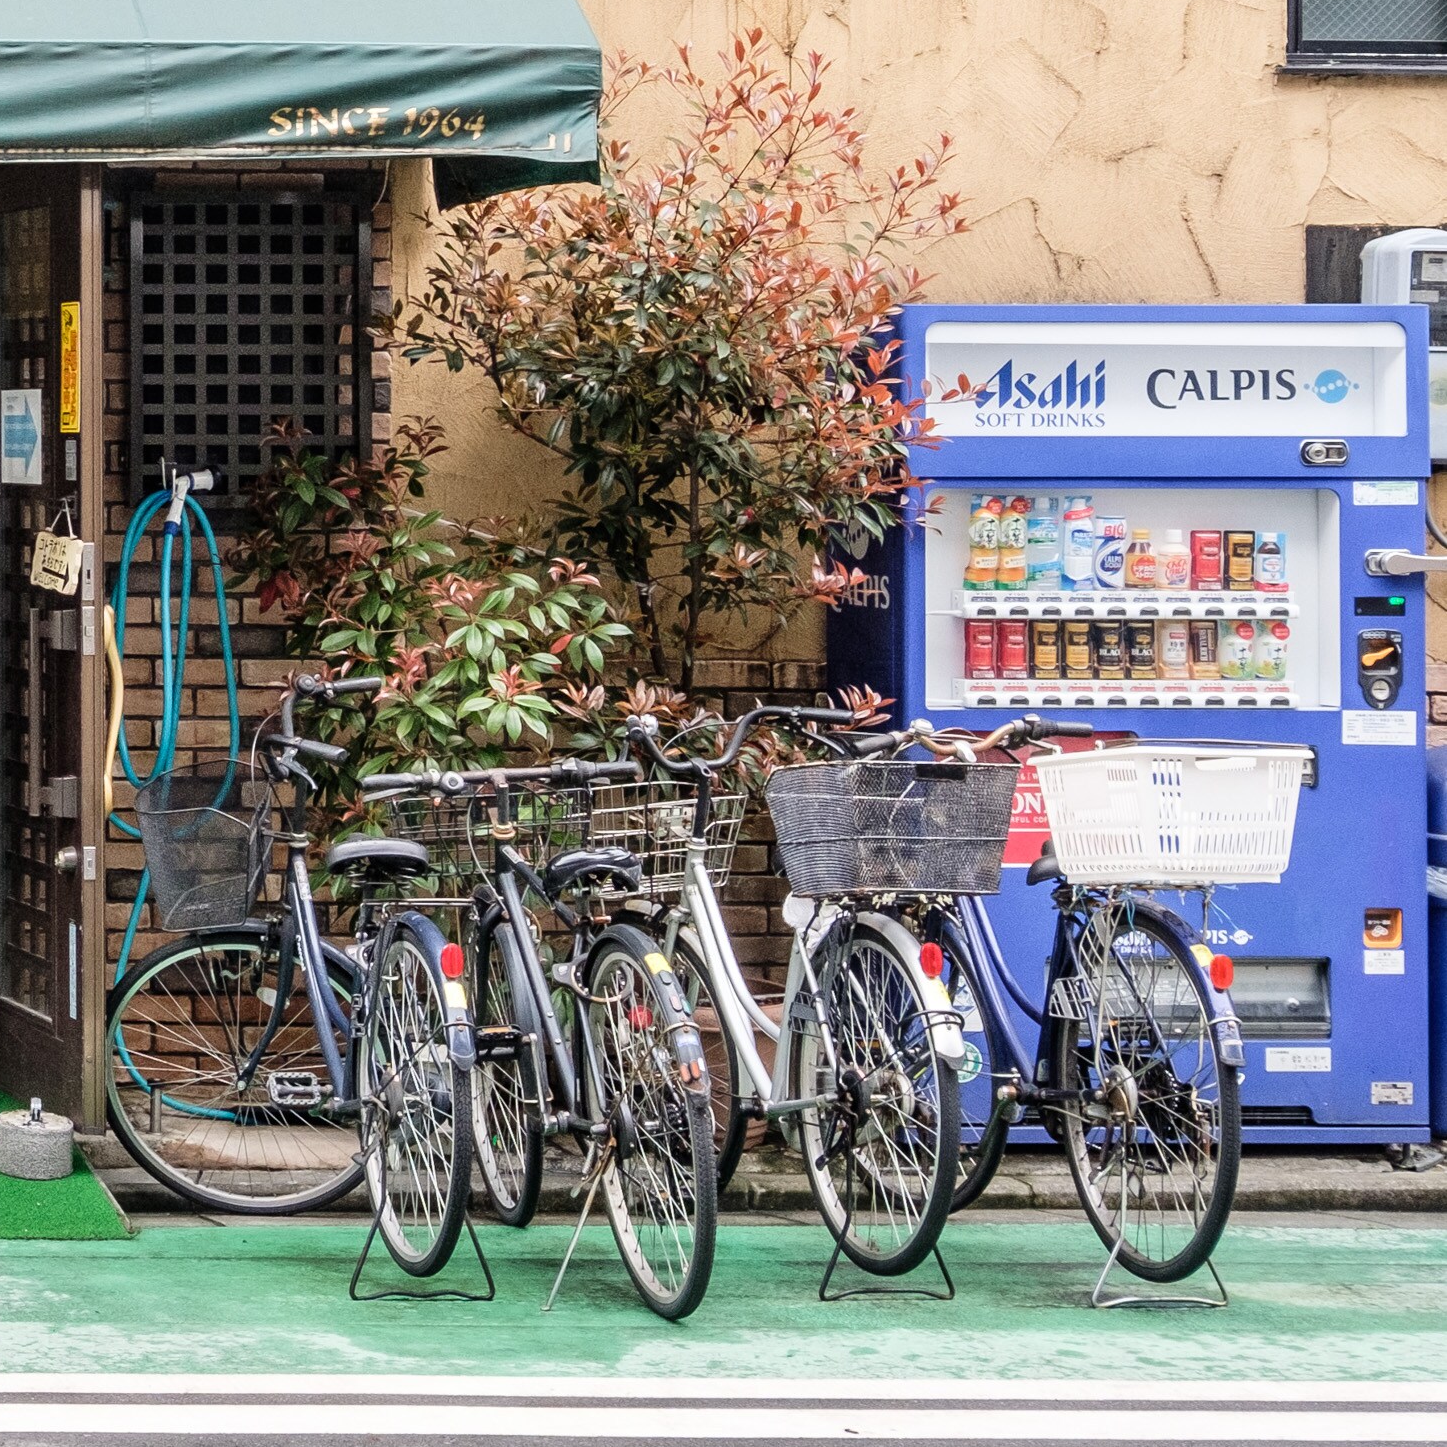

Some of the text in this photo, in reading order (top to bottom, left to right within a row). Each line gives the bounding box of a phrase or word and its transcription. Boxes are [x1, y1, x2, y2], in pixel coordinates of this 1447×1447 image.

[267, 106, 486, 141] SINCE 1964
[975, 358, 1297, 410] Asahi CALPIS
[975, 412, 1106, 429] SOFT DRINKS
